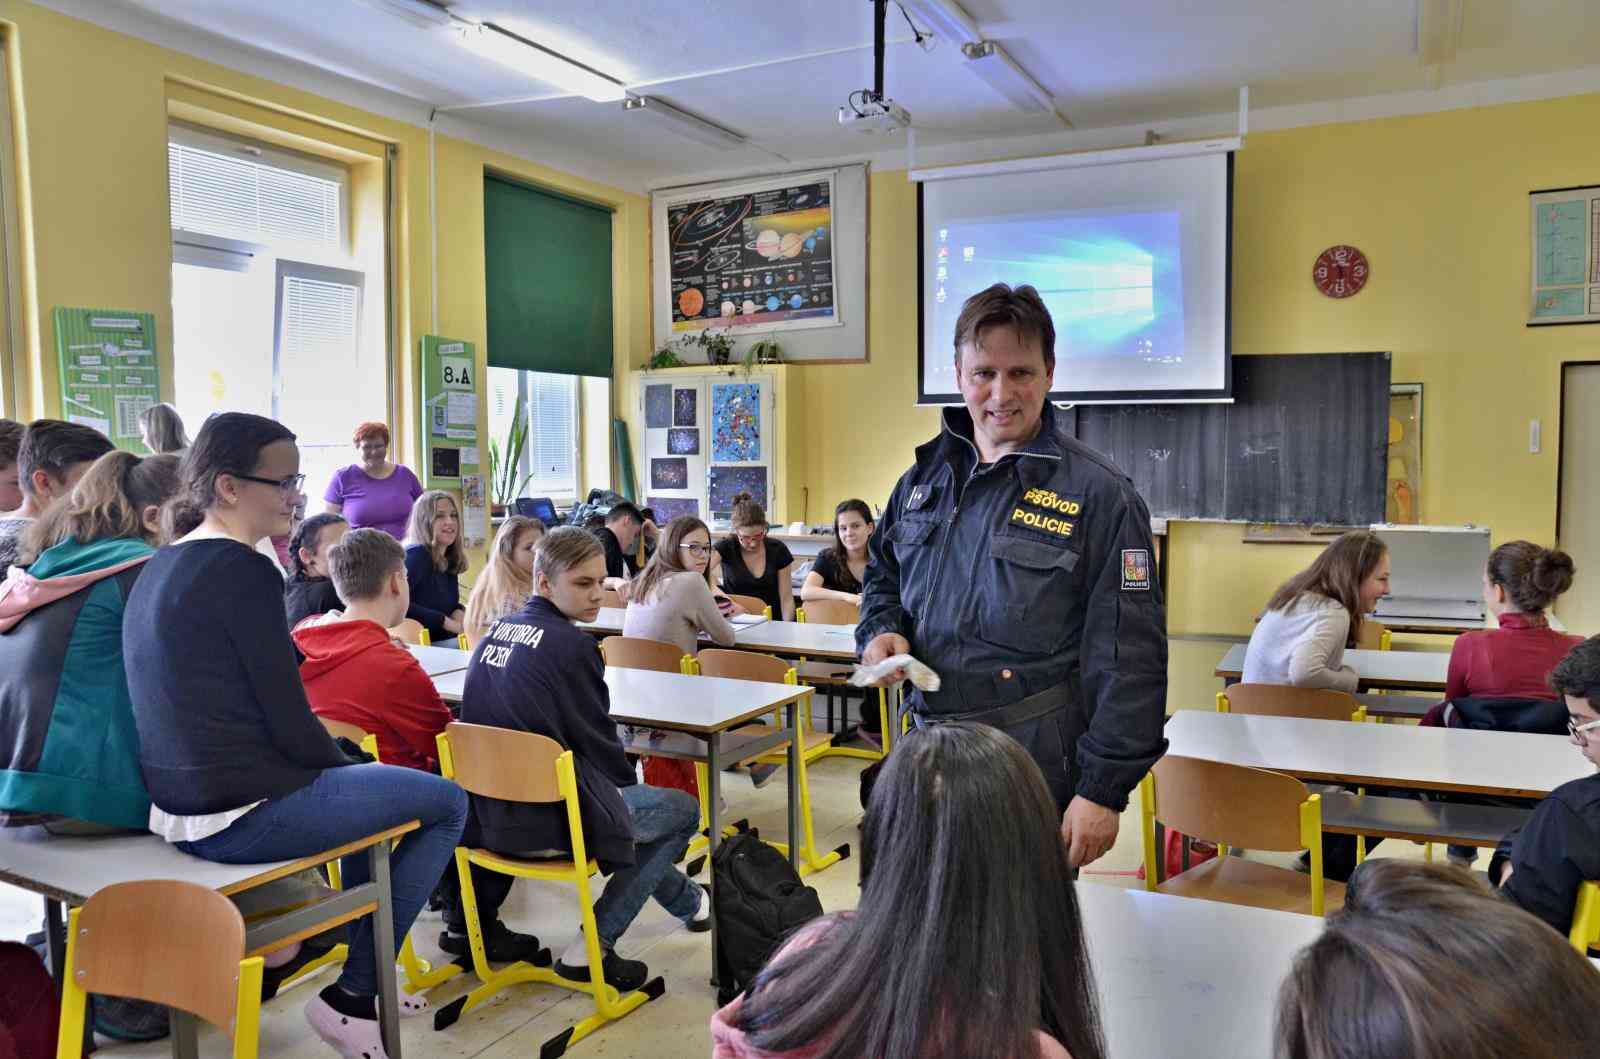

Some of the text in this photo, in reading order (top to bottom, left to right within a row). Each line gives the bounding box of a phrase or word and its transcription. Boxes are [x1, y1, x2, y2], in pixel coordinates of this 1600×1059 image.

[443, 366, 471, 385] 8.A
[1023, 490, 1080, 515] PSOVOD
[1012, 508, 1074, 536] POLICIE
[492, 622, 545, 649] VIKTORIA
